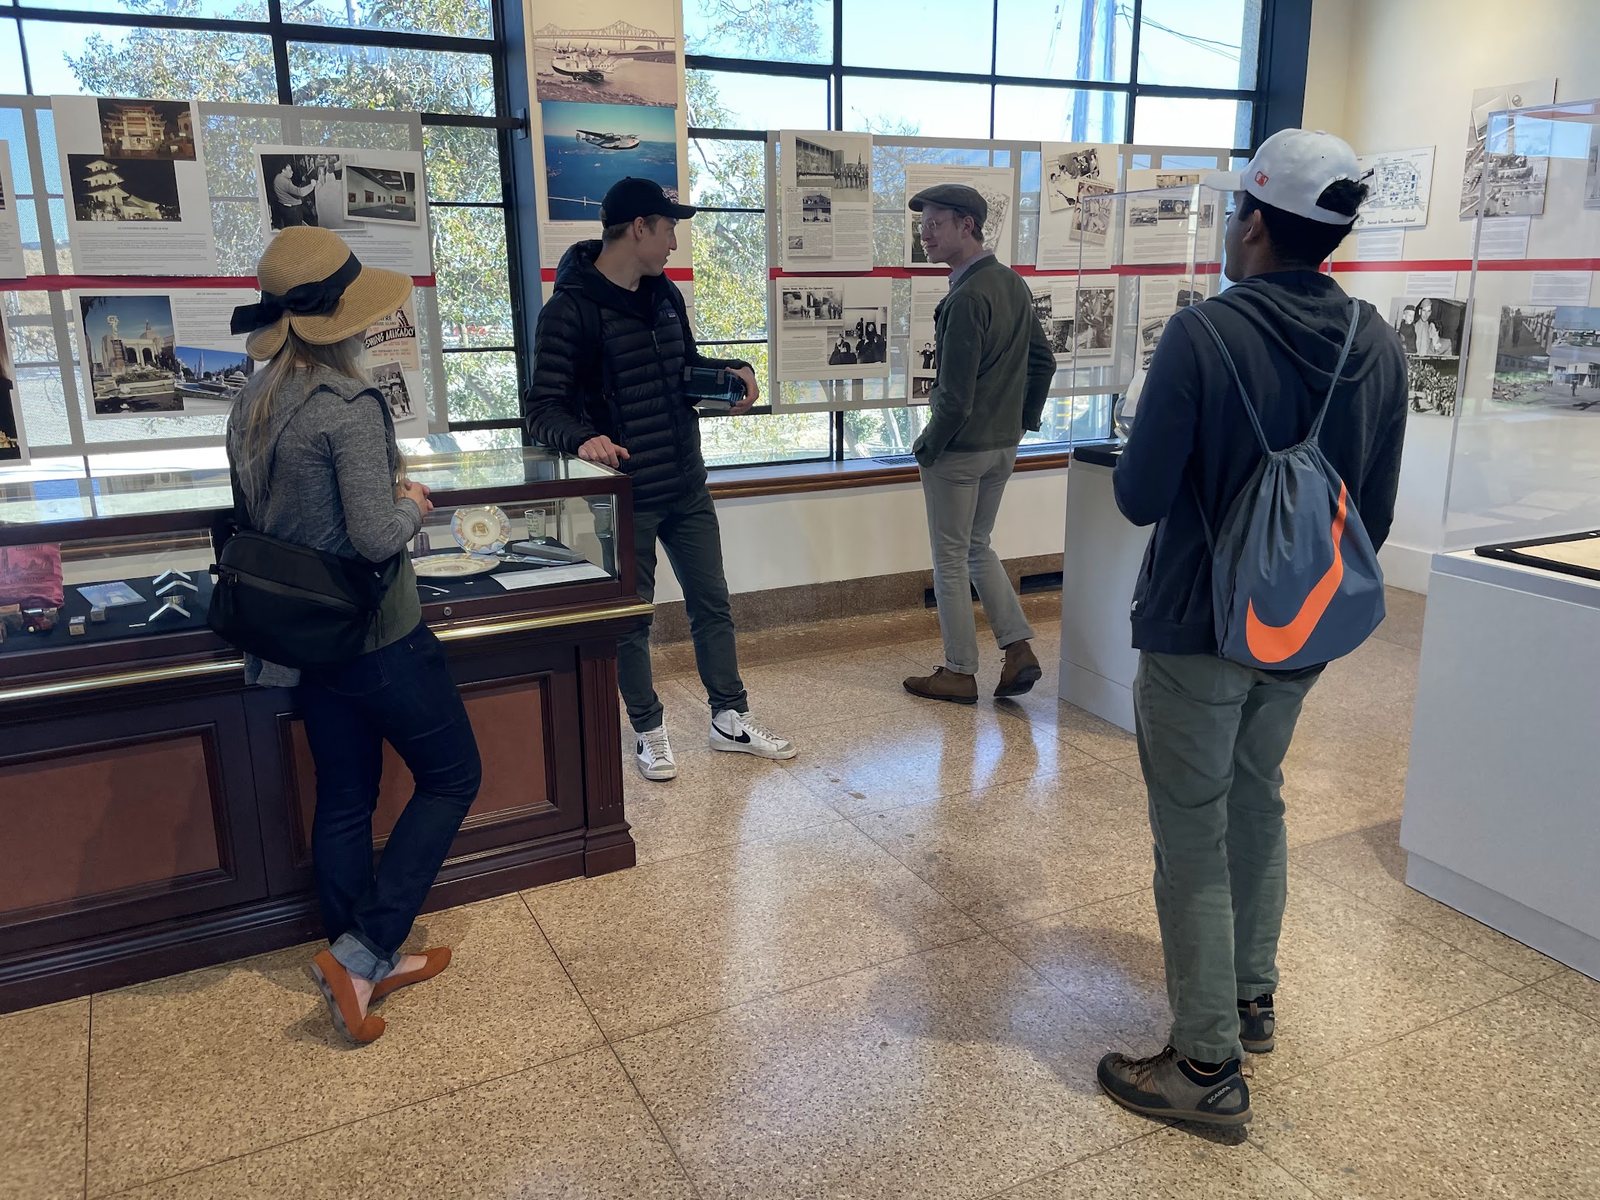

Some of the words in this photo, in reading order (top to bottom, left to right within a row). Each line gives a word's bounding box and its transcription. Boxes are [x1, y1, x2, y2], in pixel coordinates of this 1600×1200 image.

[365, 332, 384, 348] SWING
[385, 327, 414, 340] MIKADO
[1207, 1085, 1231, 1105] SCARPA
